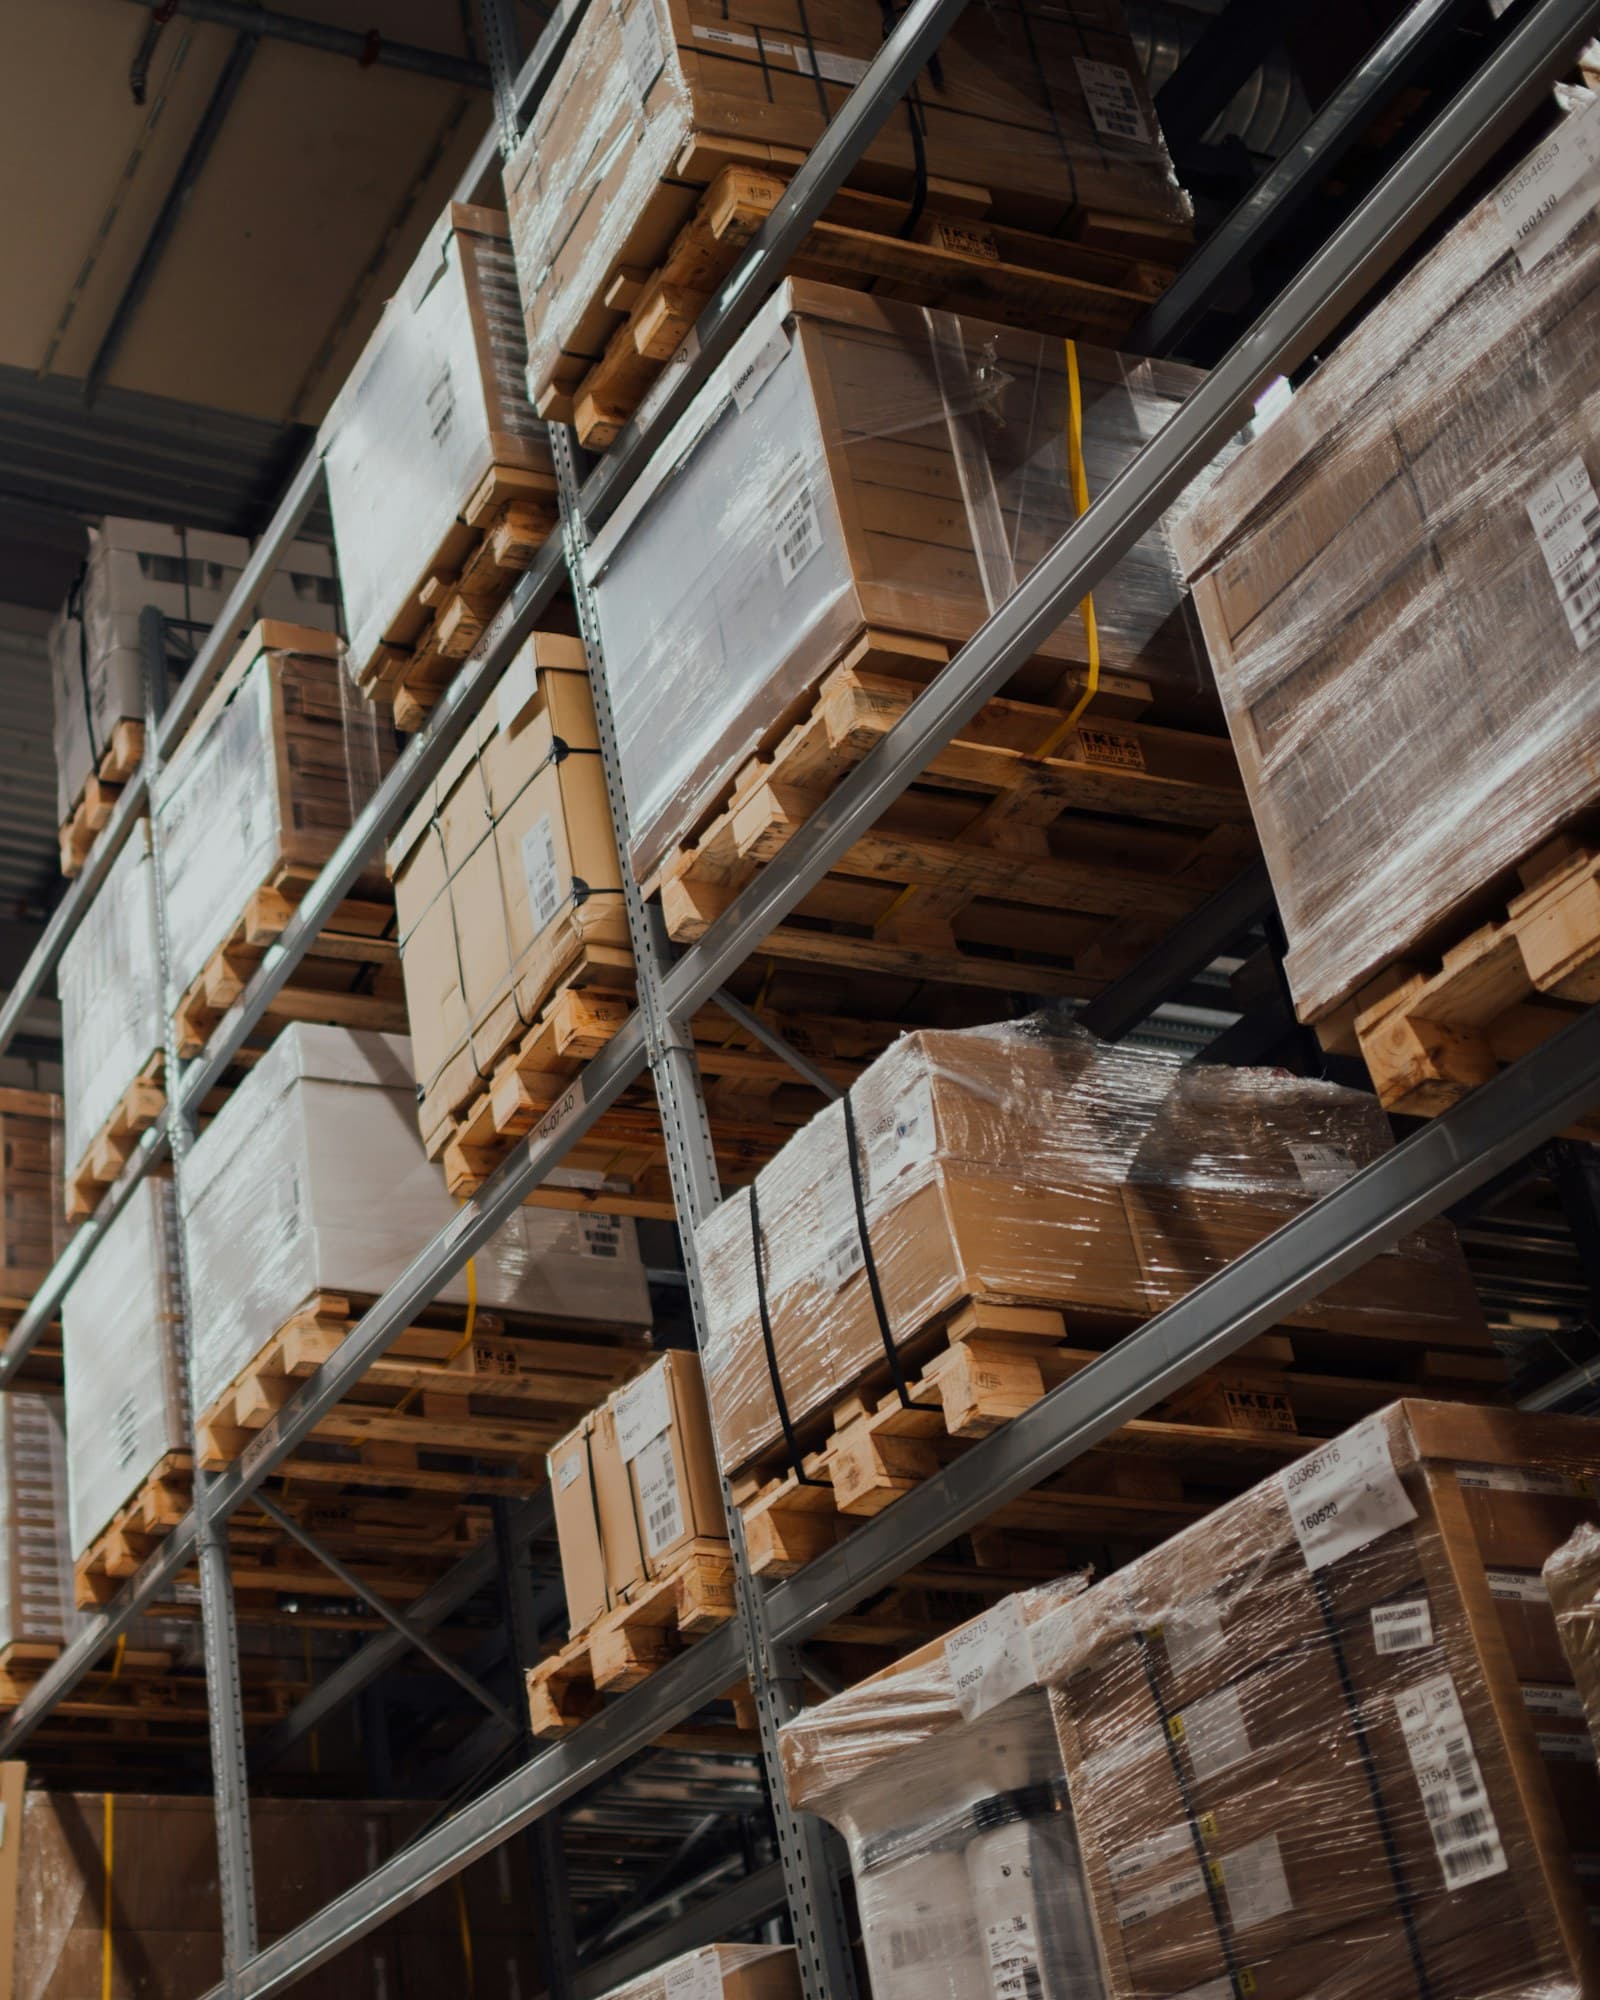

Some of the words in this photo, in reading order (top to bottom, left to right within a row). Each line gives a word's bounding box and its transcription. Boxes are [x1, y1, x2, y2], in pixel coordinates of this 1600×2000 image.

[1083, 732, 1137, 750] IKEA
[1228, 1391, 1288, 1411] IKEA
[1287, 1448, 1341, 1490] 20366116
[1300, 1501, 1339, 1532] 160520
[1418, 1767, 1452, 1789] 315kg
